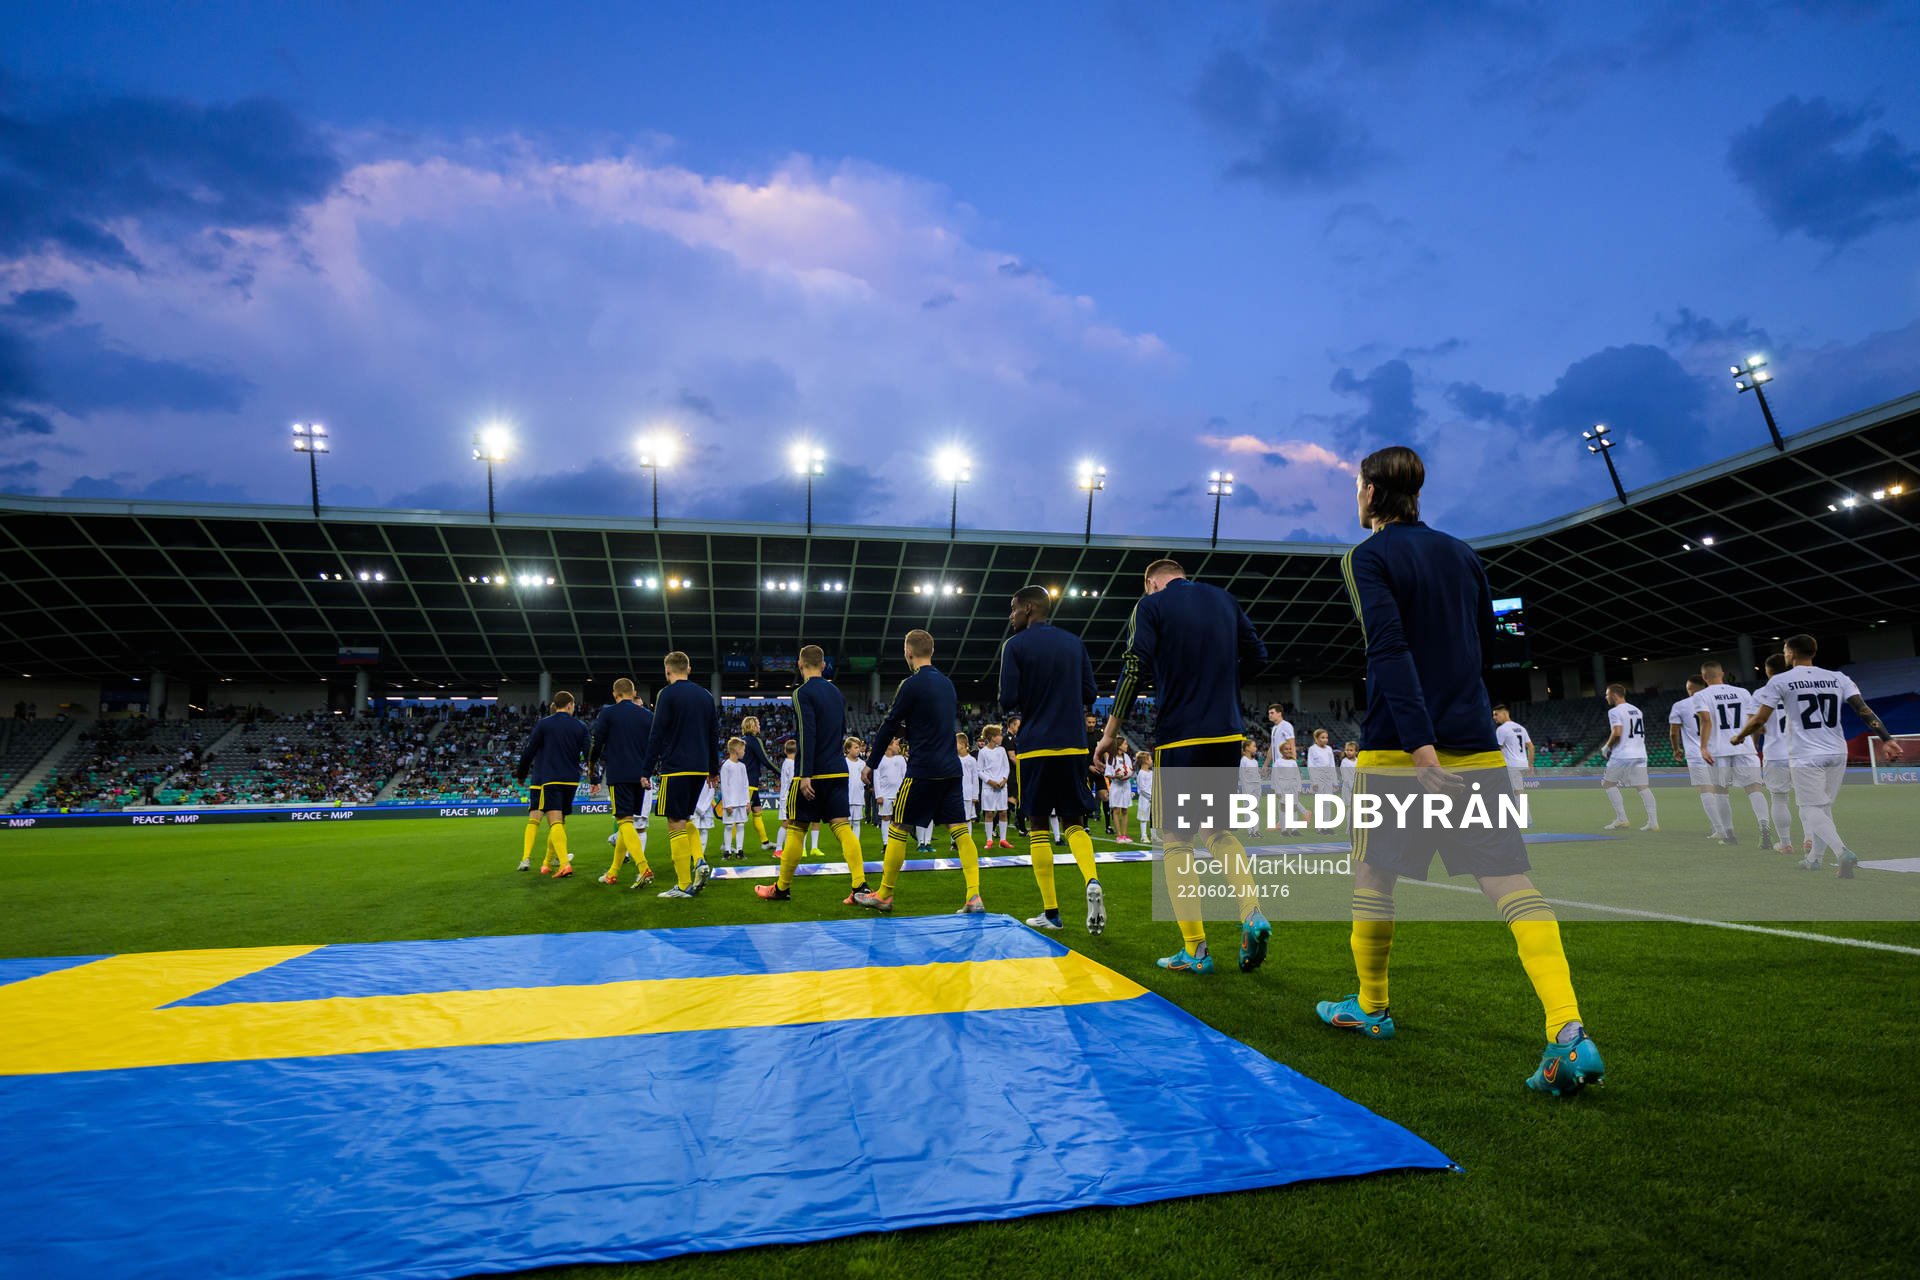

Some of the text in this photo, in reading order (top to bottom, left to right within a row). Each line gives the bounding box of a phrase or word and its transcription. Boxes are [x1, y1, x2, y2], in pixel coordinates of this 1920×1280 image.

[1717, 703, 1742, 729] 17
[1797, 693, 1838, 730] 20
[1628, 718, 1644, 738] 14
[1516, 734, 1523, 752] 1
[477, 808, 499, 816] МИР
[580, 805, 608, 813] PEACE
[132, 816, 165, 824] PEACE
[174, 815, 199, 823] МИР
[291, 812, 322, 820] PEACE
[330, 811, 353, 819] МИР
[9, 819, 36, 827] МИР
